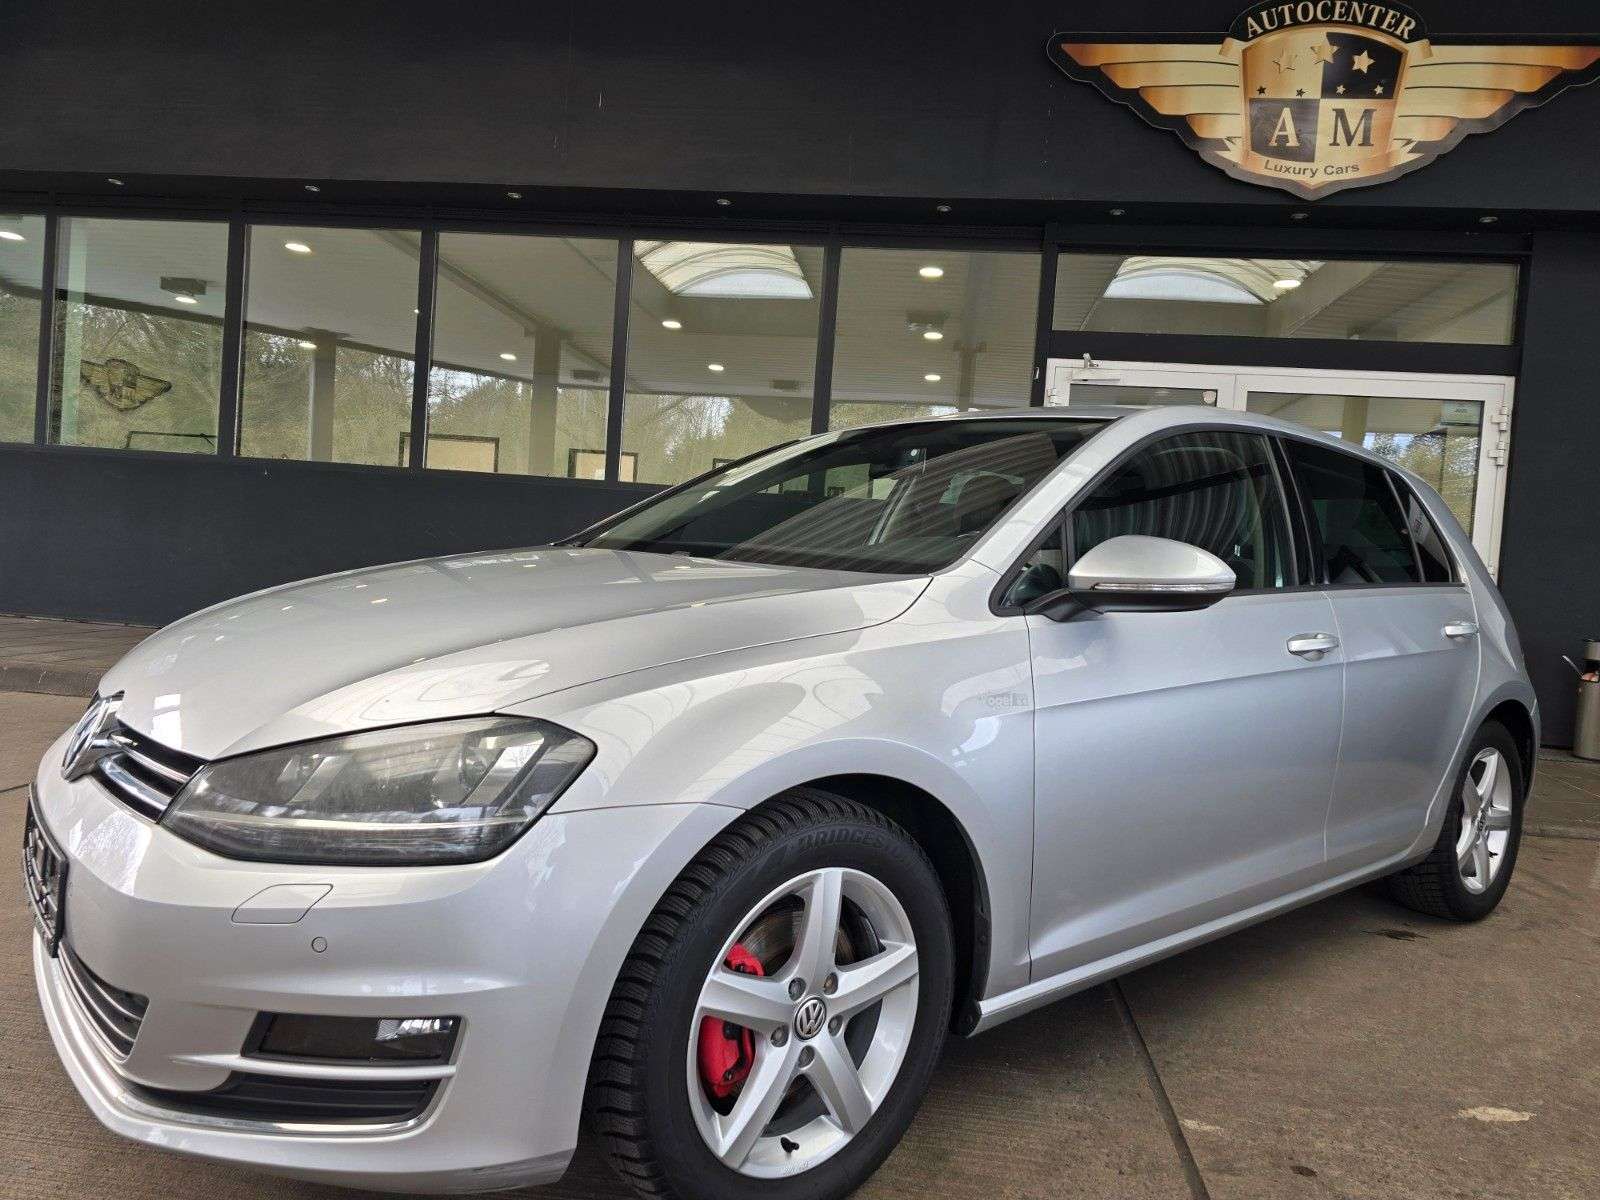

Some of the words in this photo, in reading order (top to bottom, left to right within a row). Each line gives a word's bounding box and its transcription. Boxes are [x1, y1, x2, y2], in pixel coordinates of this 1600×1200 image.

[1246, 0, 1416, 39] AUTOCENTER
[1268, 107, 1300, 147] A
[1329, 108, 1377, 147] M
[1264, 159, 1319, 178] Luxury
[1323, 163, 1360, 176] Cars
